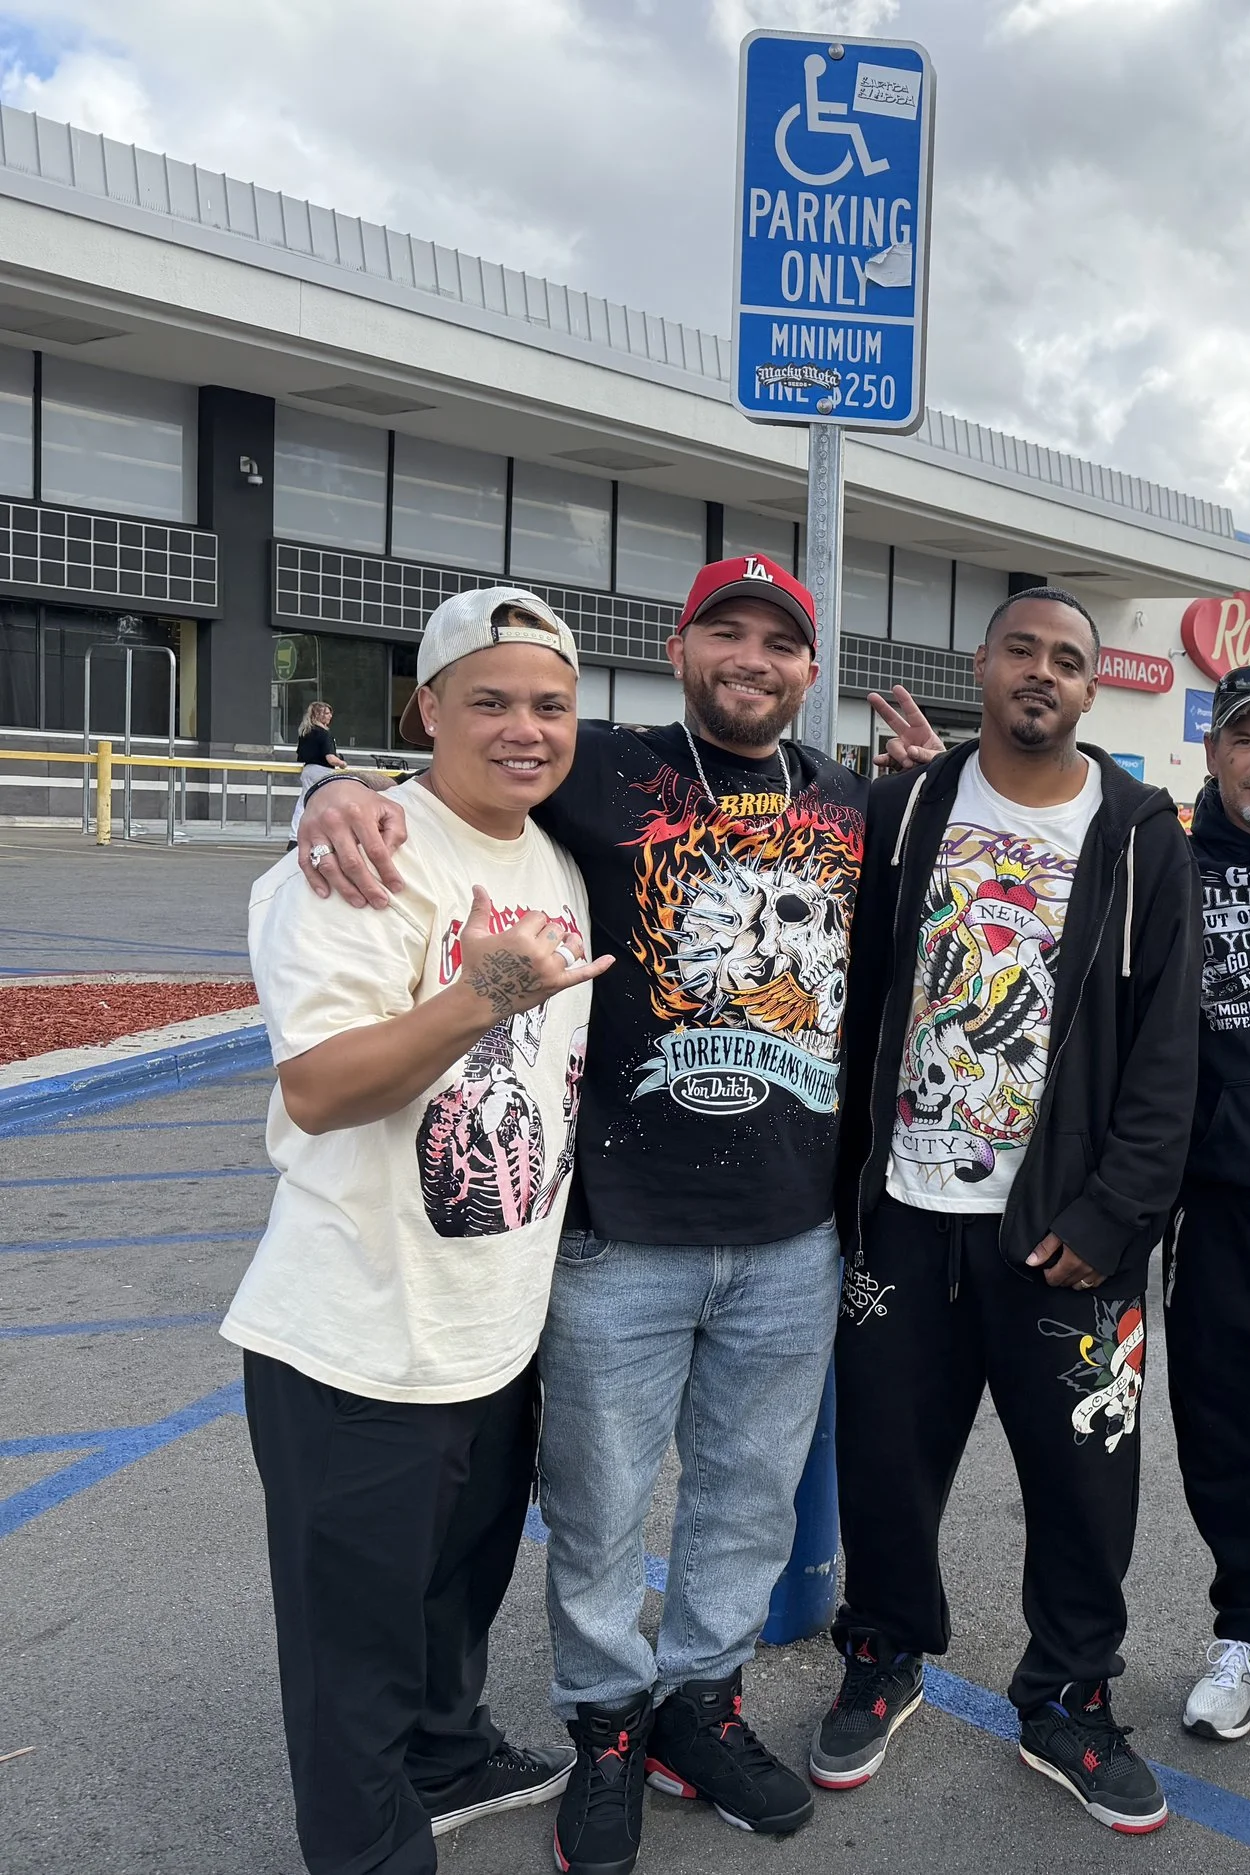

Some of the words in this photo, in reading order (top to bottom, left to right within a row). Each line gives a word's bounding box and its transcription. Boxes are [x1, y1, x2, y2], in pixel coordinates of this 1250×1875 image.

[749, 188, 911, 248] PARKING
[781, 250, 869, 306] ONLY
[771, 323, 881, 364] MINIMUM
[743, 557, 774, 582] LA
[1098, 655, 1168, 686] ARMACY
[976, 904, 1035, 928] NEW
[1226, 951, 1248, 974] GO
[671, 1035, 754, 1072] FOREVER
[756, 1040, 801, 1085] MEANS
[681, 1076, 710, 1099] Von
[710, 1076, 755, 1098] Dutch
[902, 1135, 959, 1154] CITY
[1077, 1376, 1128, 1422] LOVE
